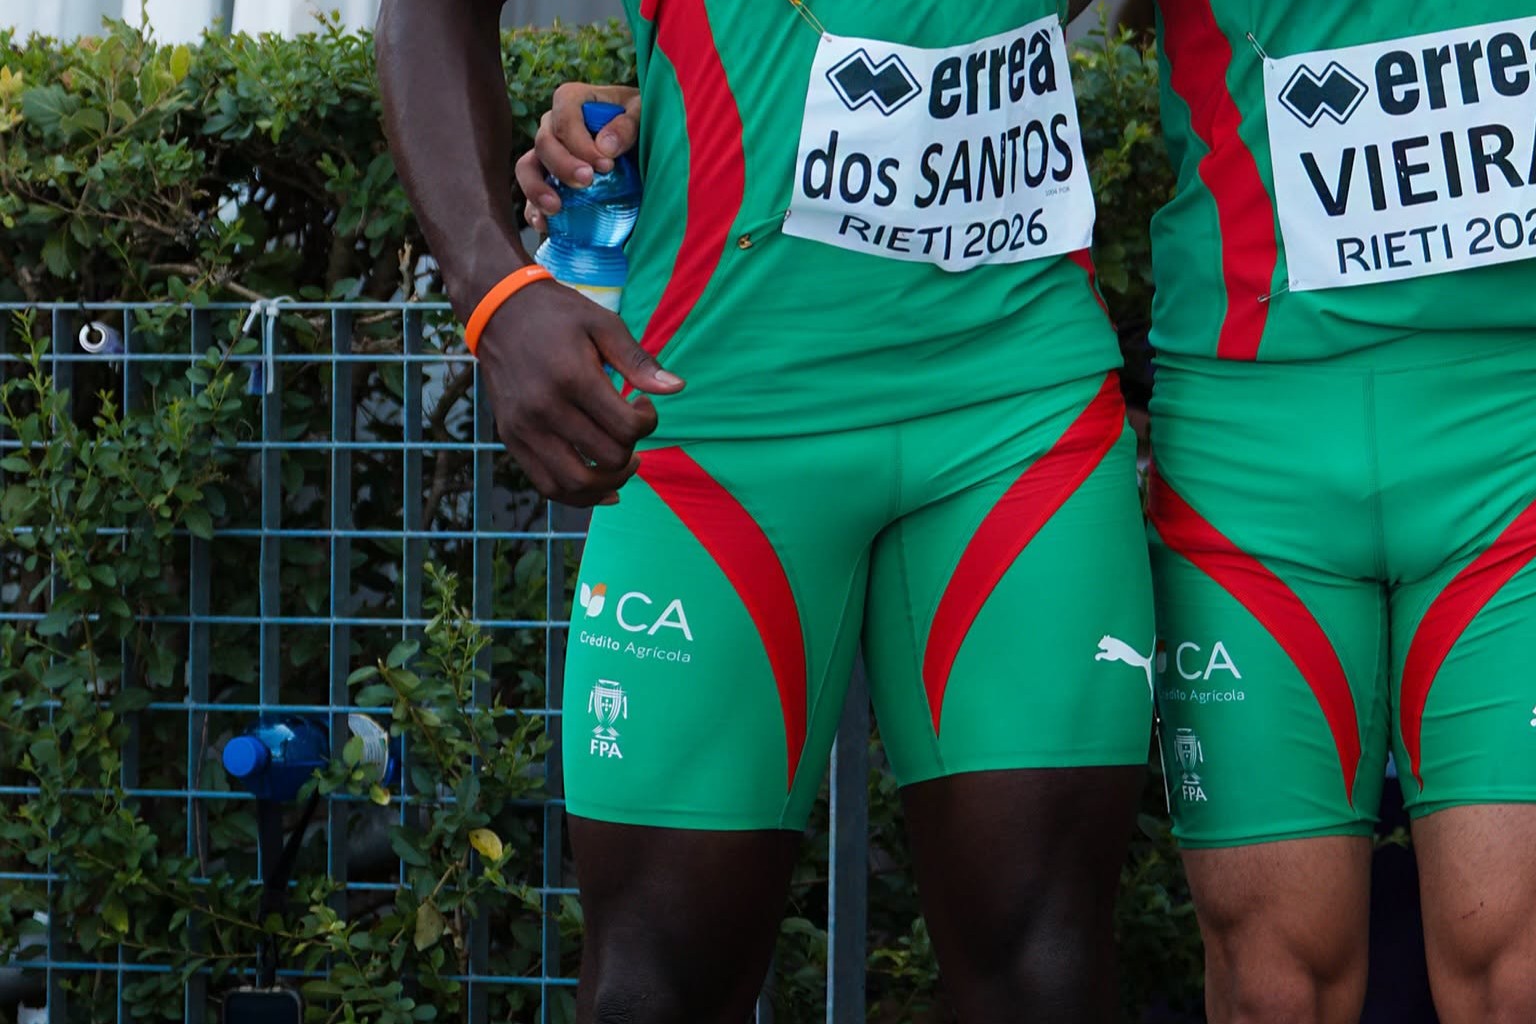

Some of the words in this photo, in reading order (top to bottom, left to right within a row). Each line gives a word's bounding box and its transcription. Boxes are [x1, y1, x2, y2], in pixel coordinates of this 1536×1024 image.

[802, 130, 900, 207] dos
[914, 113, 1073, 209] SANTOS
[839, 215, 952, 260] RIETI
[963, 209, 1048, 258] 2026
[1337, 224, 1453, 274] RIETI
[616, 591, 693, 642] CA
[580, 631, 620, 651] Crédito
[624, 642, 691, 663] Agrícola
[1176, 641, 1242, 680] CA
[1189, 689, 1245, 704] Agrícola
[590, 739, 623, 759] FPA
[1182, 785, 1207, 801] FPA
